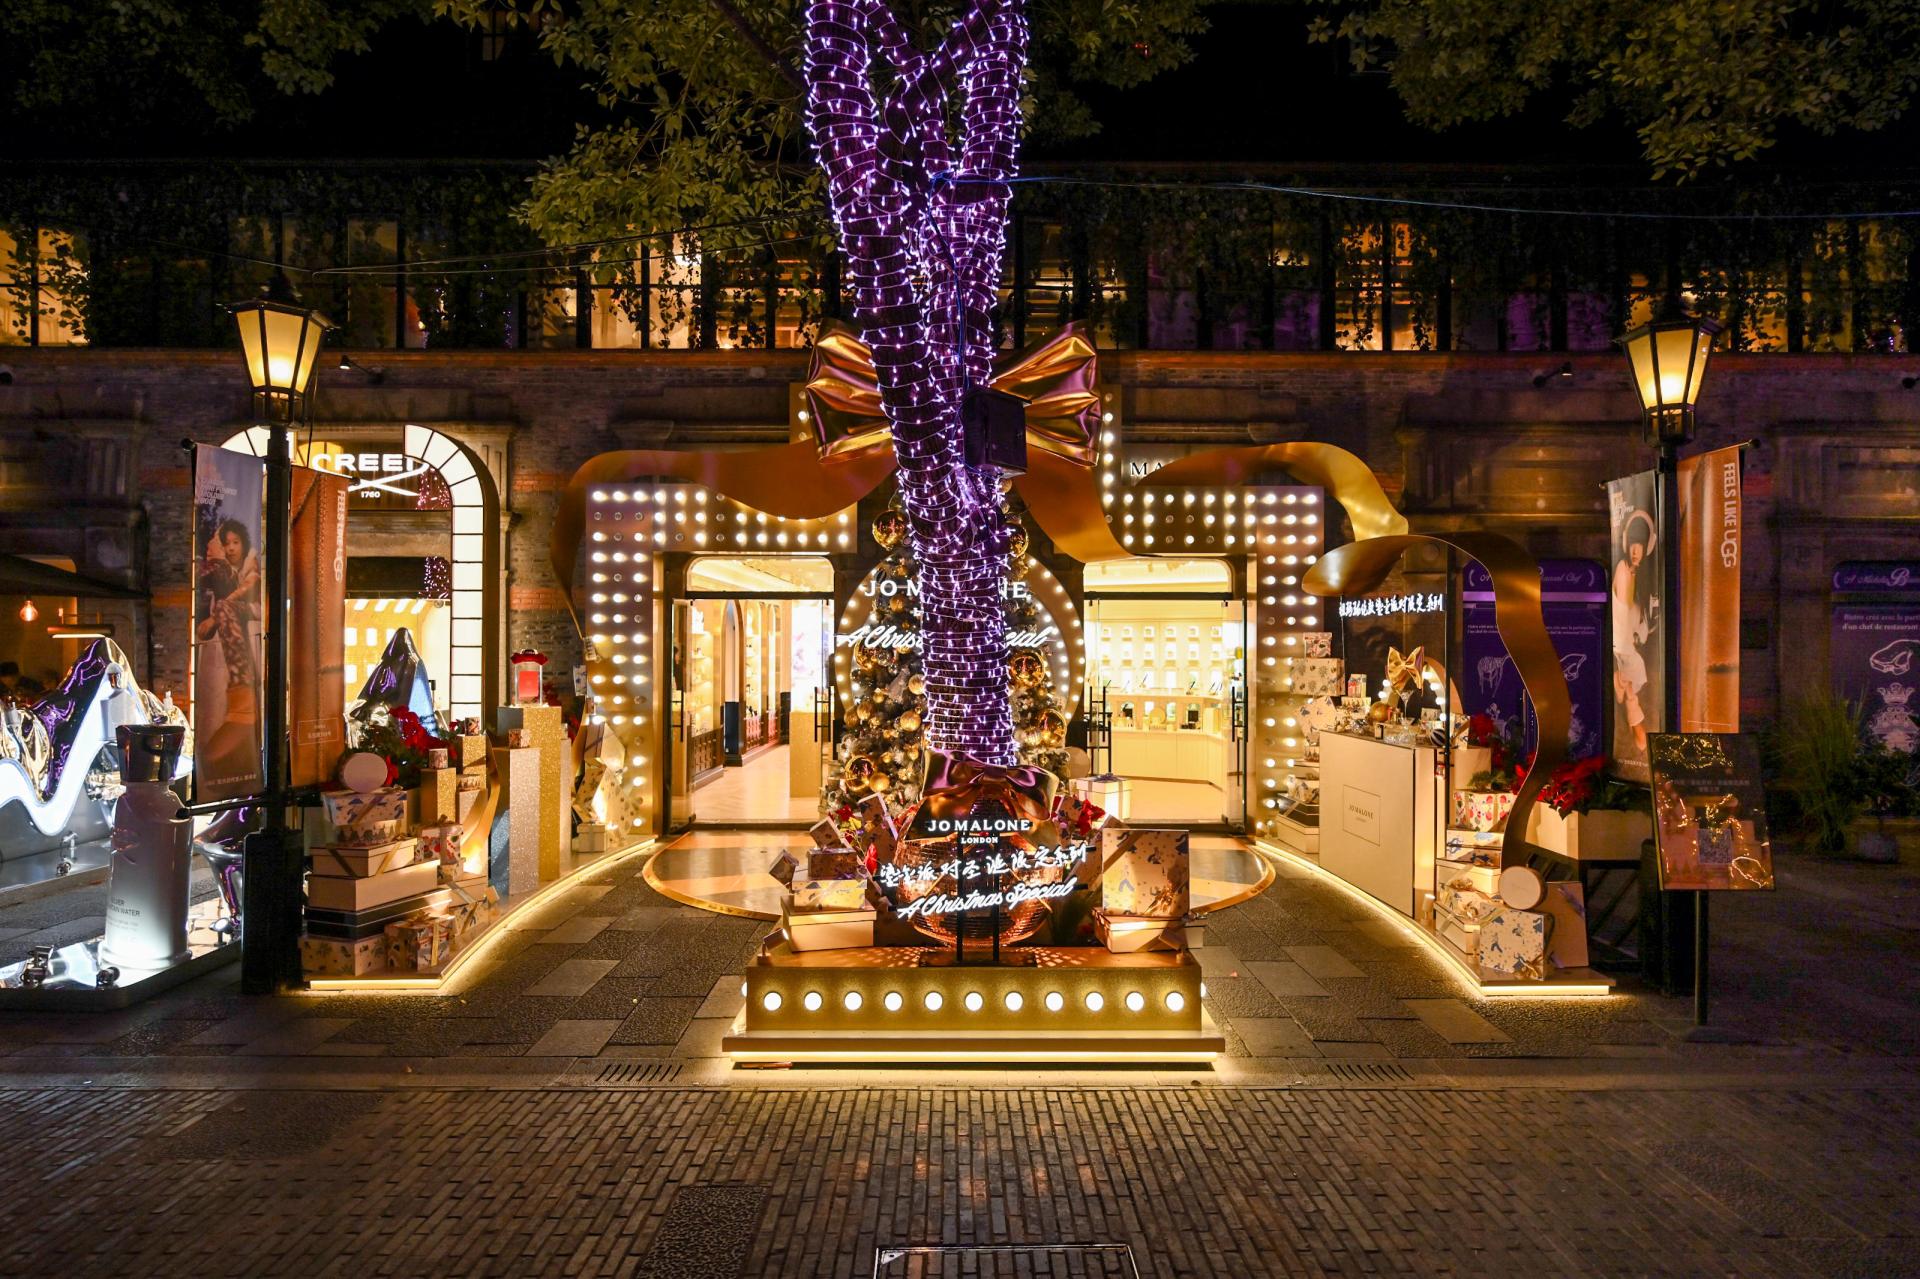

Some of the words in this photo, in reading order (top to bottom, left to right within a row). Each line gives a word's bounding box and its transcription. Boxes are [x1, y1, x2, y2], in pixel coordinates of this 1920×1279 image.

[1724, 462, 1737, 498] FEELS
[1724, 501, 1737, 527] LIKE
[1720, 530, 1738, 569] UGG
[865, 580, 897, 597] JO
[928, 820, 950, 831] JO
[954, 820, 1030, 831] MALONE
[898, 898, 921, 919] A
[921, 889, 1003, 916] Christmas
[1005, 877, 1078, 910] Special
